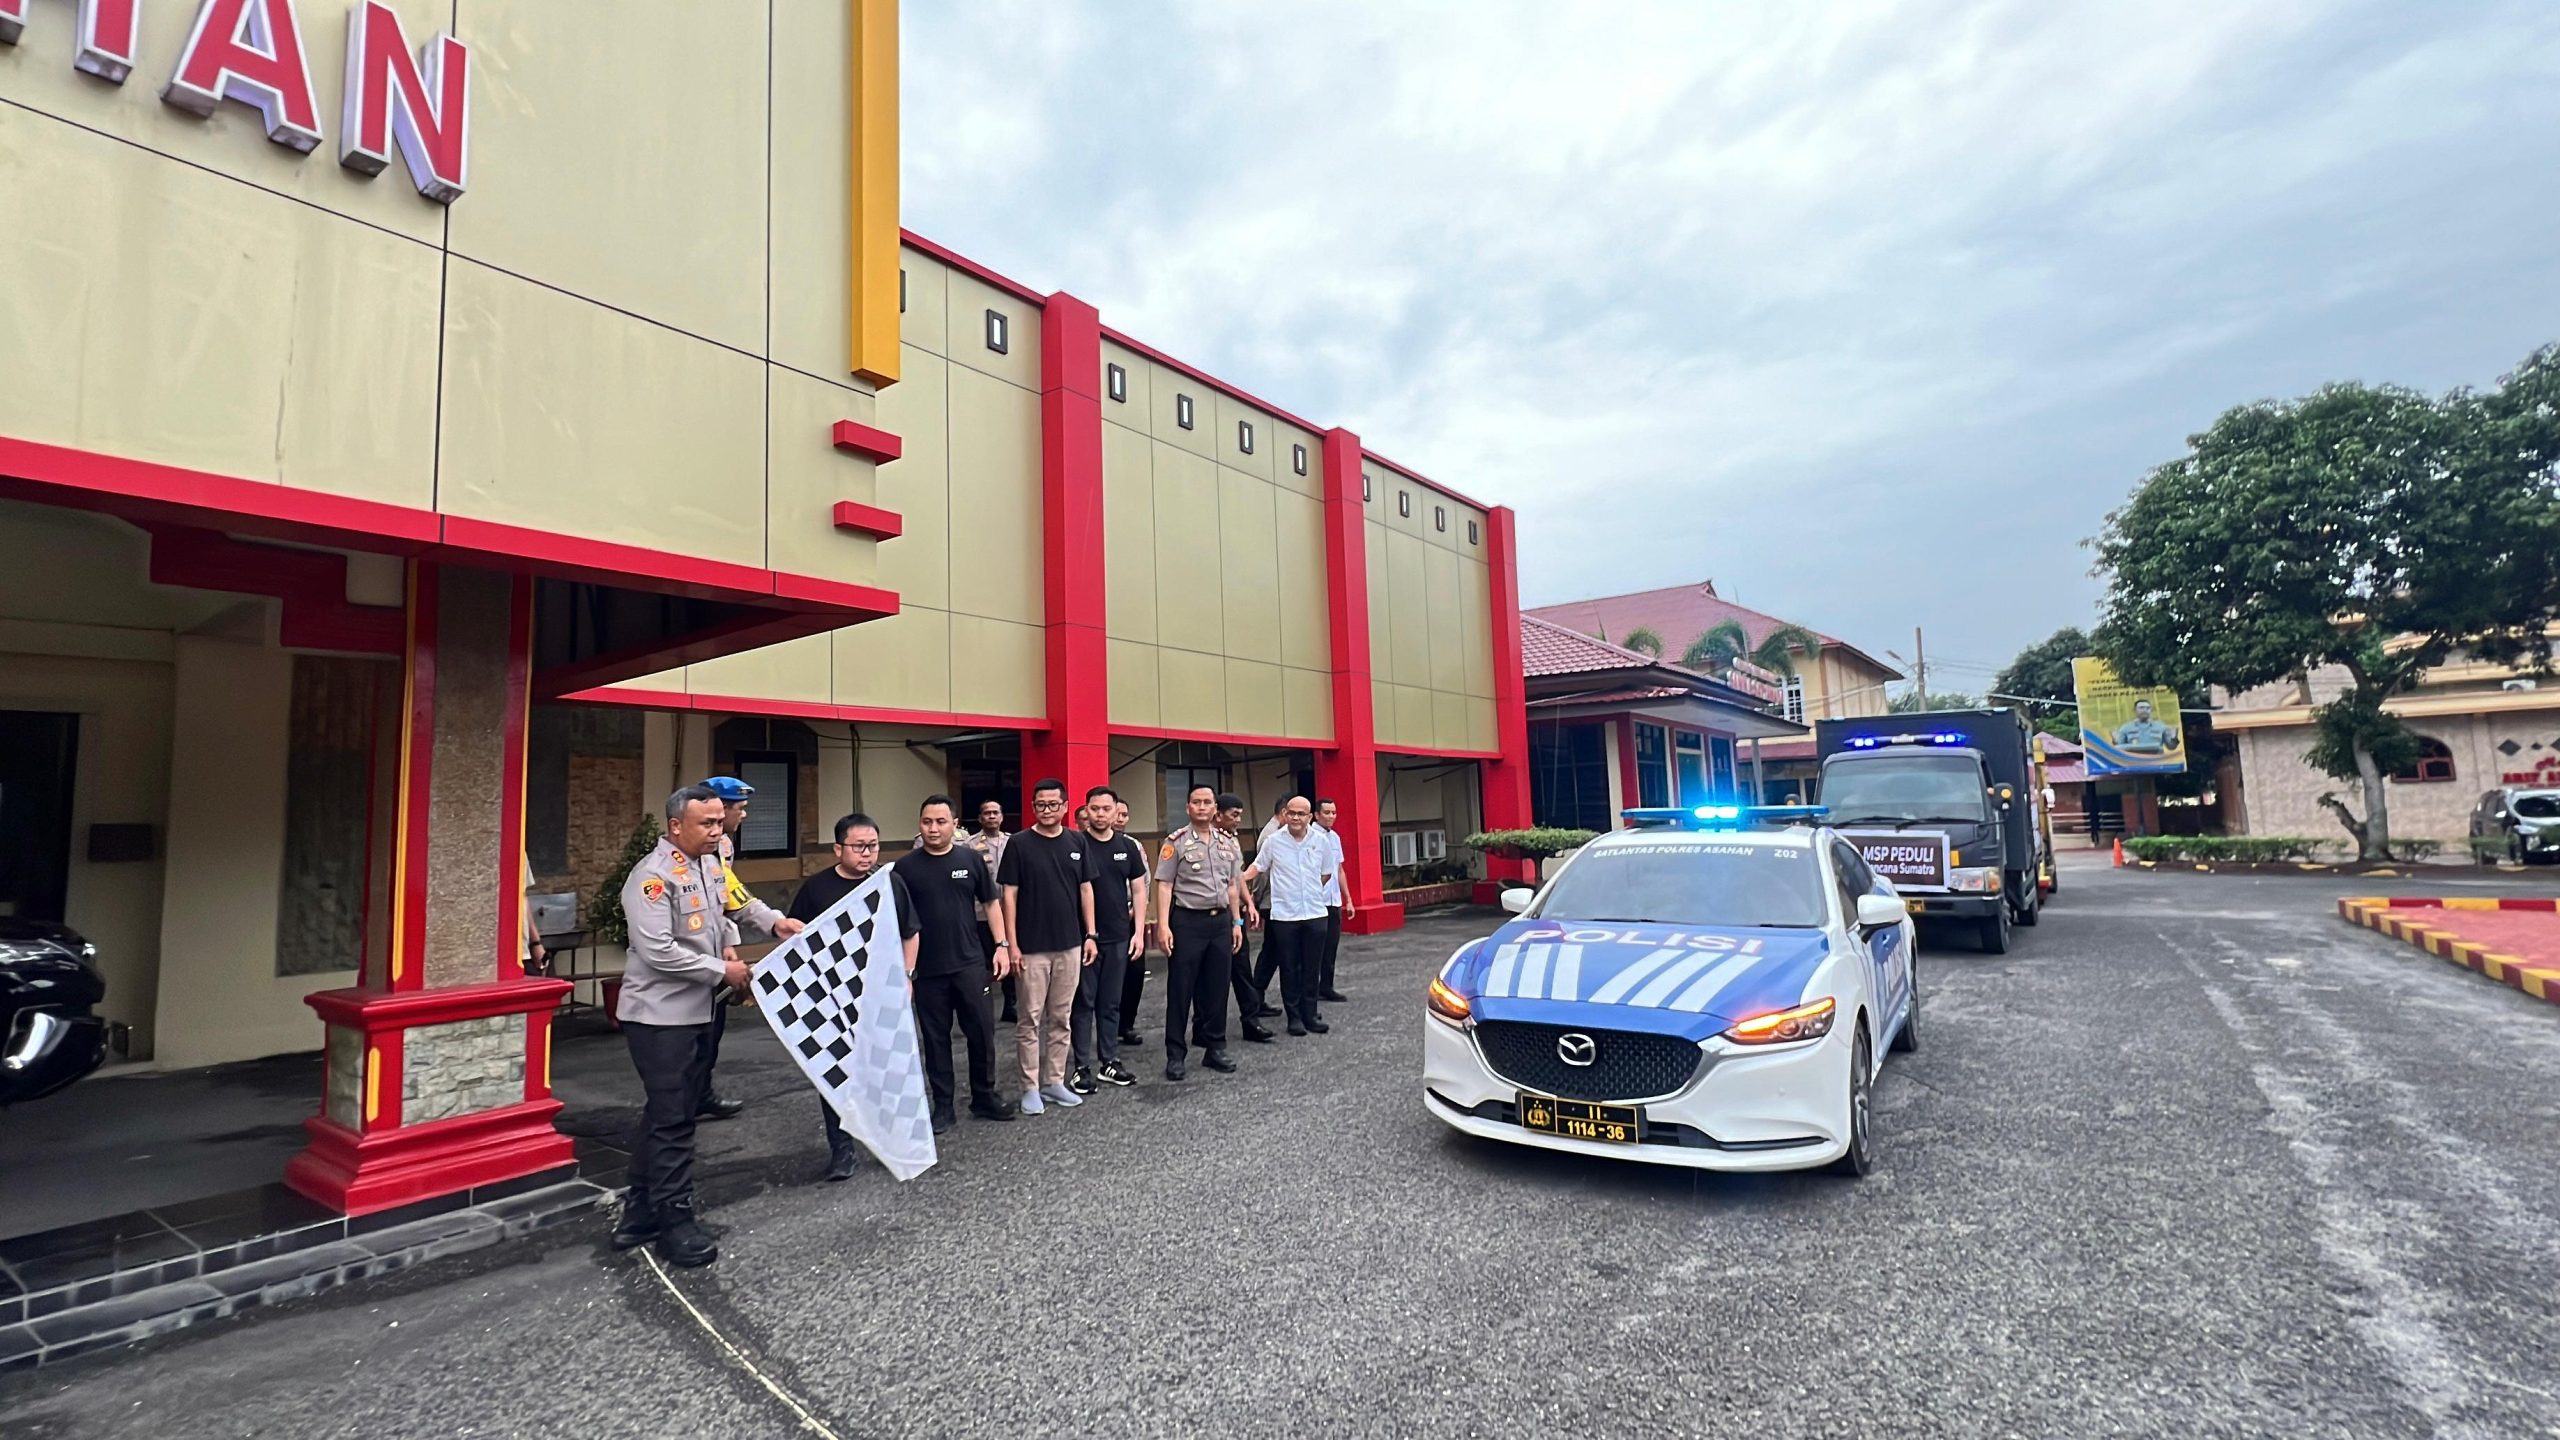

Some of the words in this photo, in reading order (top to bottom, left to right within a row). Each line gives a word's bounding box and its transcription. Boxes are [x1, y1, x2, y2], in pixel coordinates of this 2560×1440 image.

[1593, 847, 1654, 858] SATLANTAS
[1655, 846, 1700, 854] POLRES
[1704, 846, 1753, 856] ASAHAN
[1863, 846, 1889, 861] MSP
[1890, 847, 1934, 862] PEDULI
[1900, 862, 1935, 875] Sumatra
[1513, 930, 1762, 954] POLISI
[1567, 1120, 1625, 1140] 1114-36
